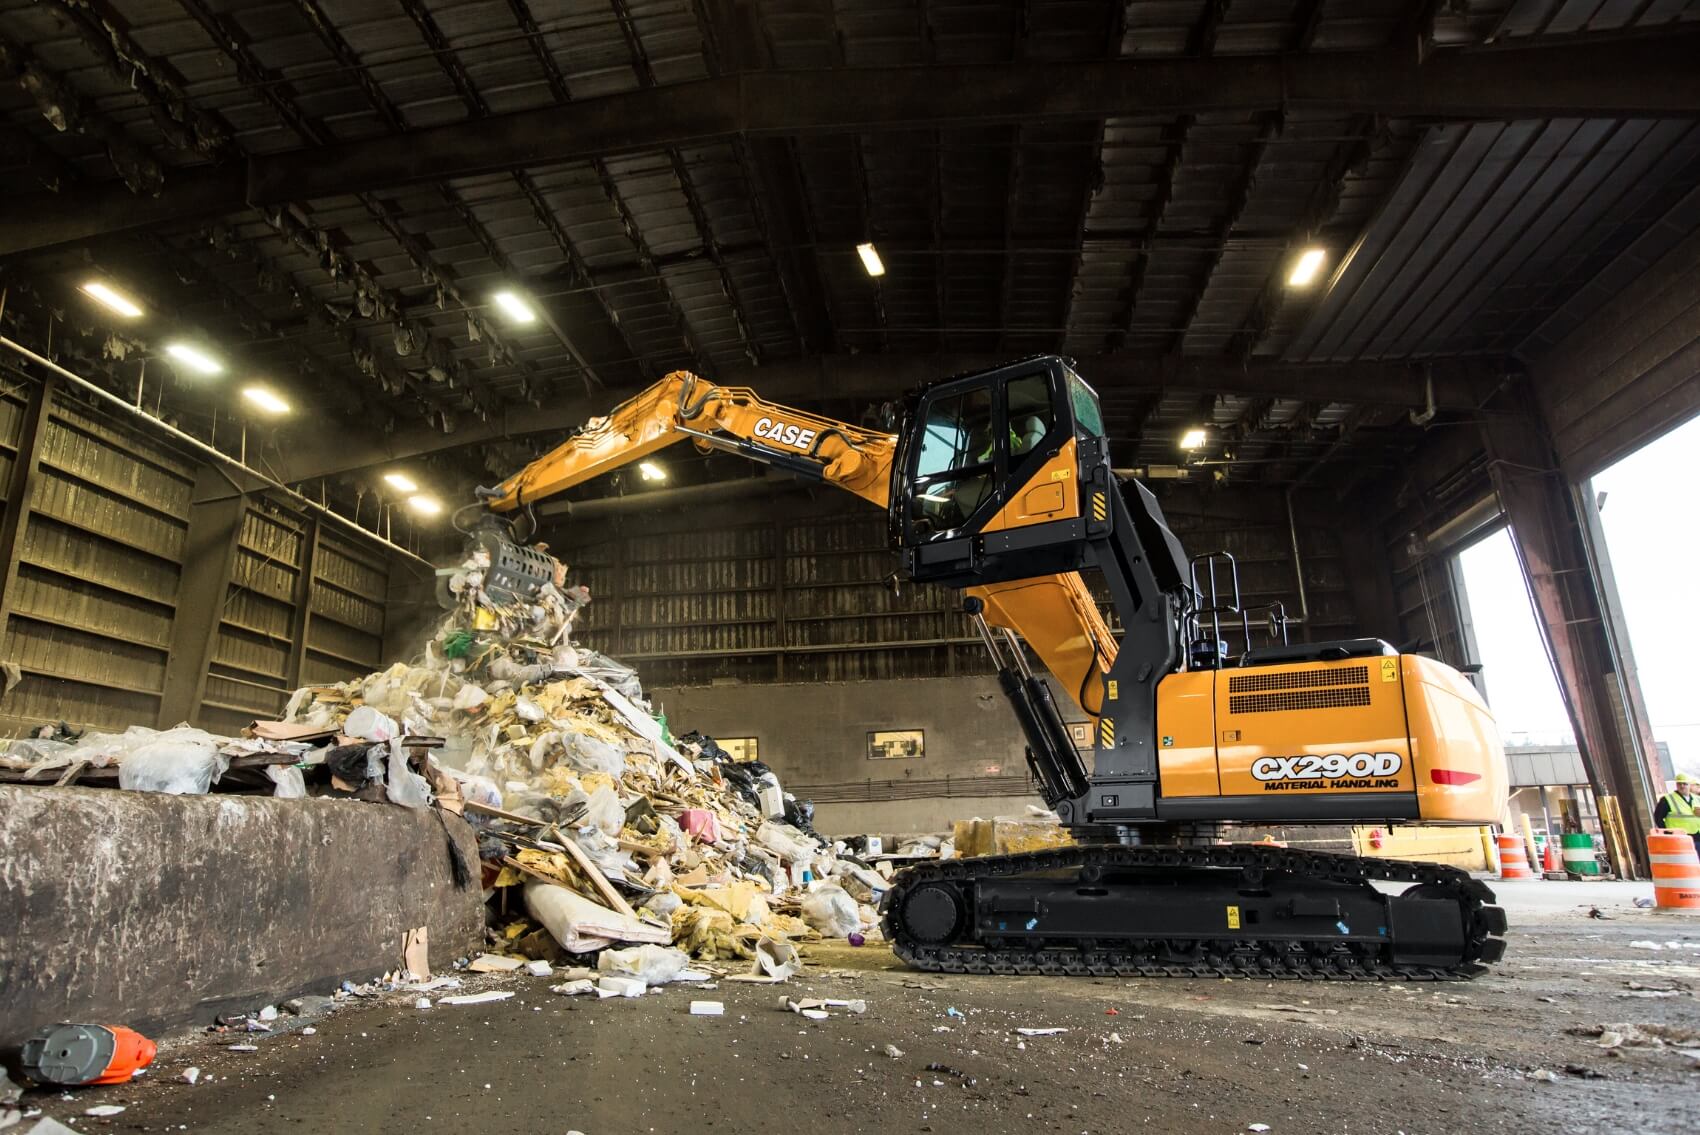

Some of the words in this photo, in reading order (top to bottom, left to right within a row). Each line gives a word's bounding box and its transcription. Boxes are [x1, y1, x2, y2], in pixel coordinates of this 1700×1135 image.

[754, 417, 816, 449] CASE
[1251, 752, 1402, 781] CX290D
[1264, 782, 1327, 791] MATERIAL
[1330, 779, 1399, 789] HANDLING
